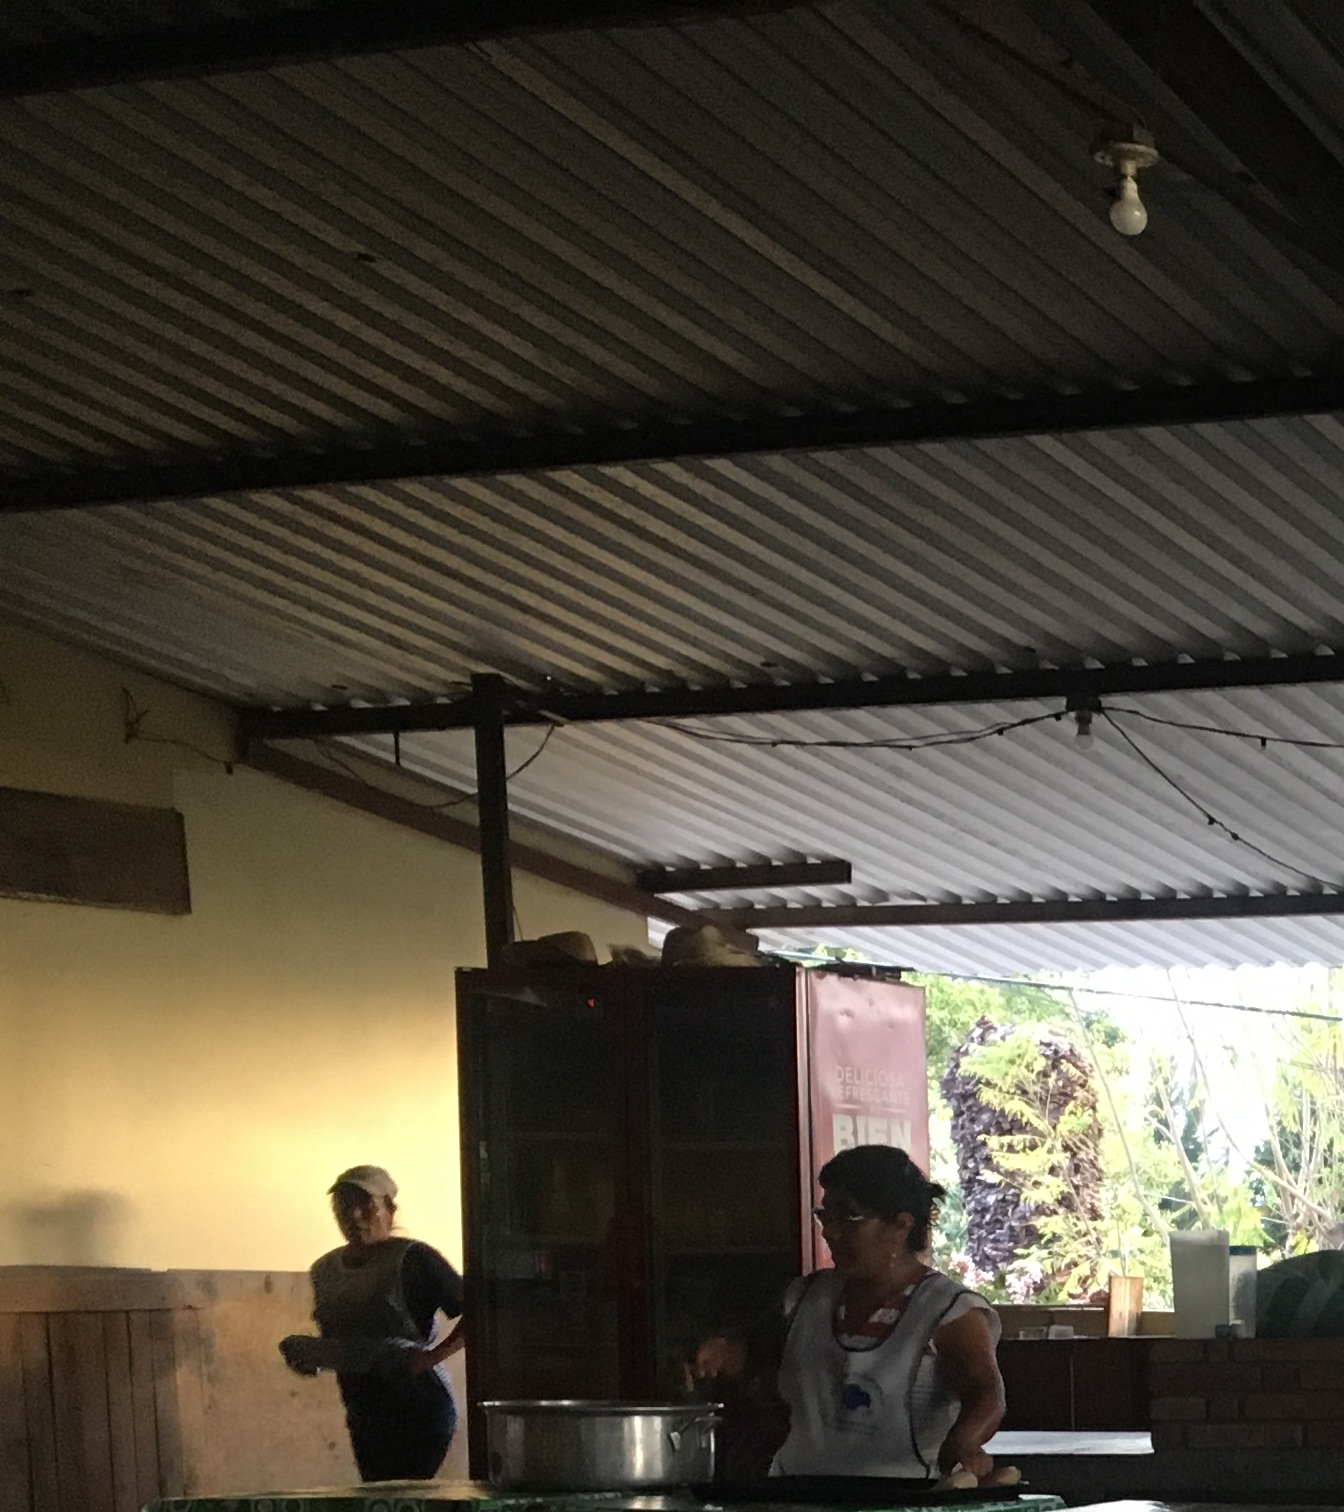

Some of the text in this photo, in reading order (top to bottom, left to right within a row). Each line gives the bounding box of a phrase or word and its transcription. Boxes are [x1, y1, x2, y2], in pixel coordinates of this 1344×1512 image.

[834, 1065, 904, 1087] DELICIOSA
[832, 1085, 910, 1105] EFRESCANTE
[832, 1114, 912, 1155] BIEN
